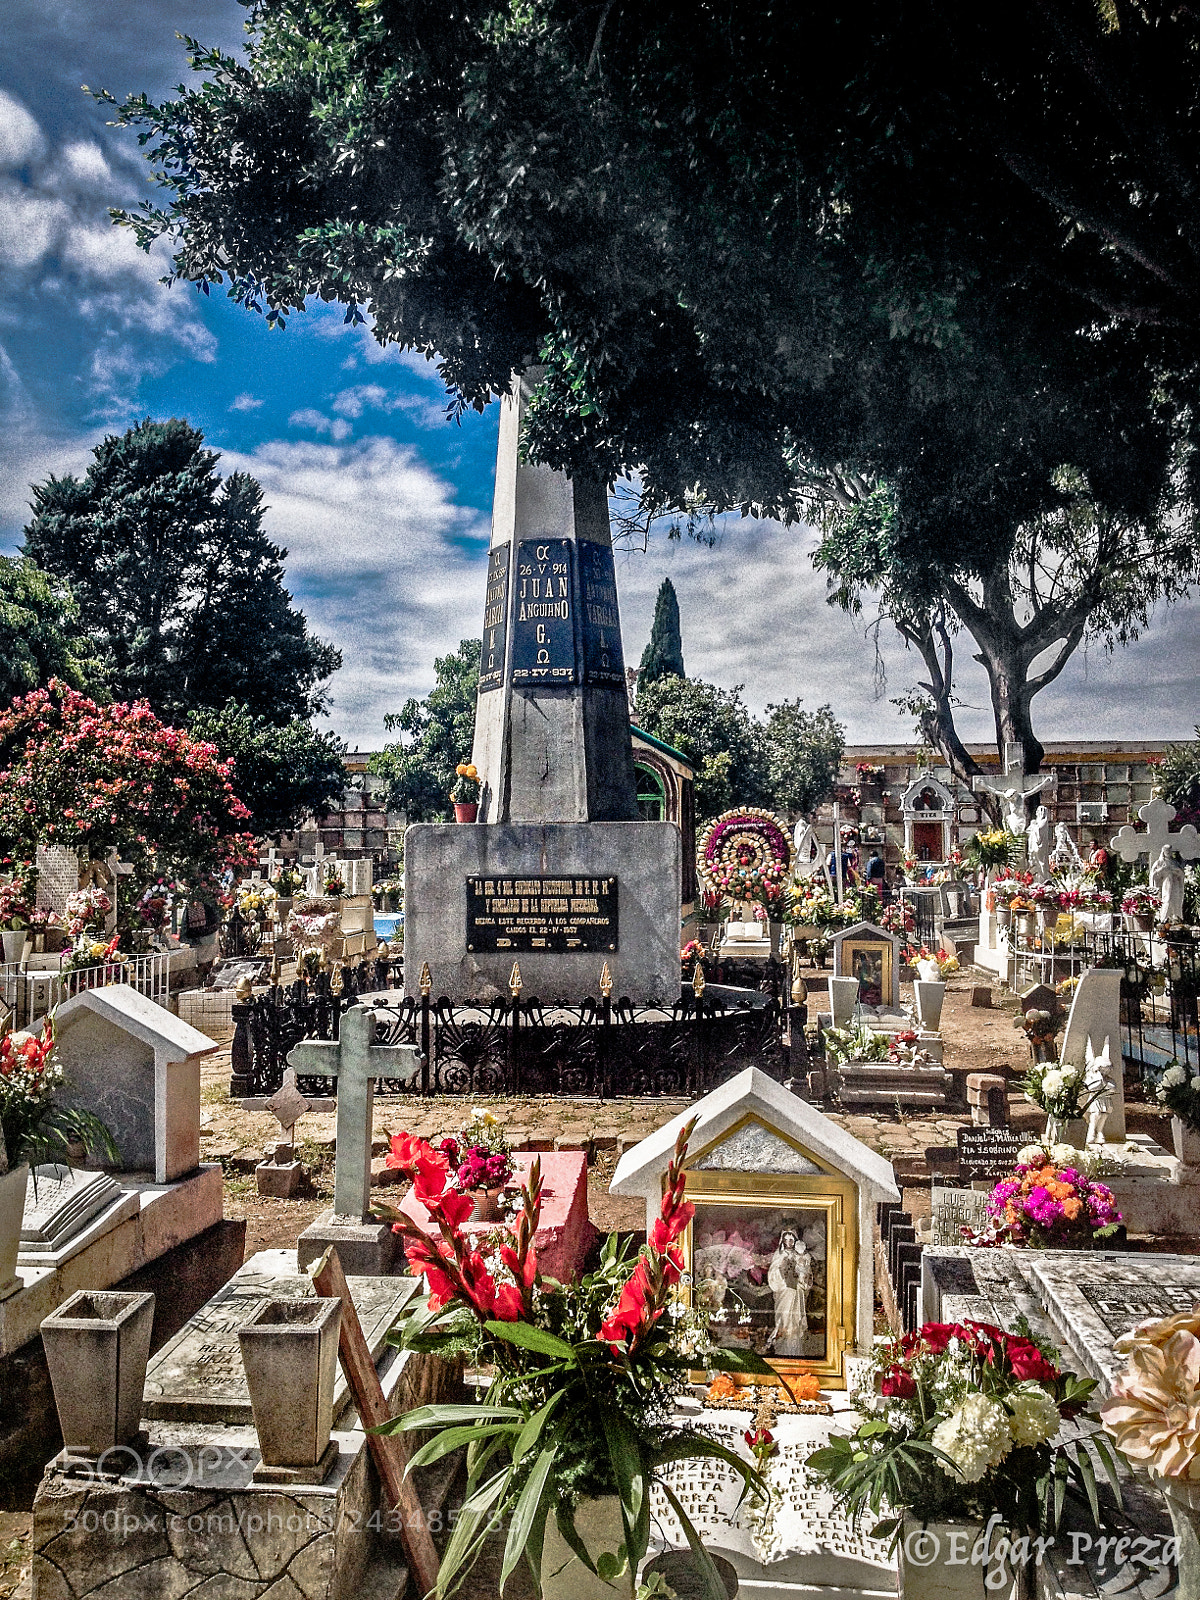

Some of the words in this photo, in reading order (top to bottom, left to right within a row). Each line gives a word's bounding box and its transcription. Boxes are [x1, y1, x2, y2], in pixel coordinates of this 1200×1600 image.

[520, 577, 568, 599] JUAN
[519, 600, 569, 621] ANGUIANO
[536, 624, 551, 644] G.
